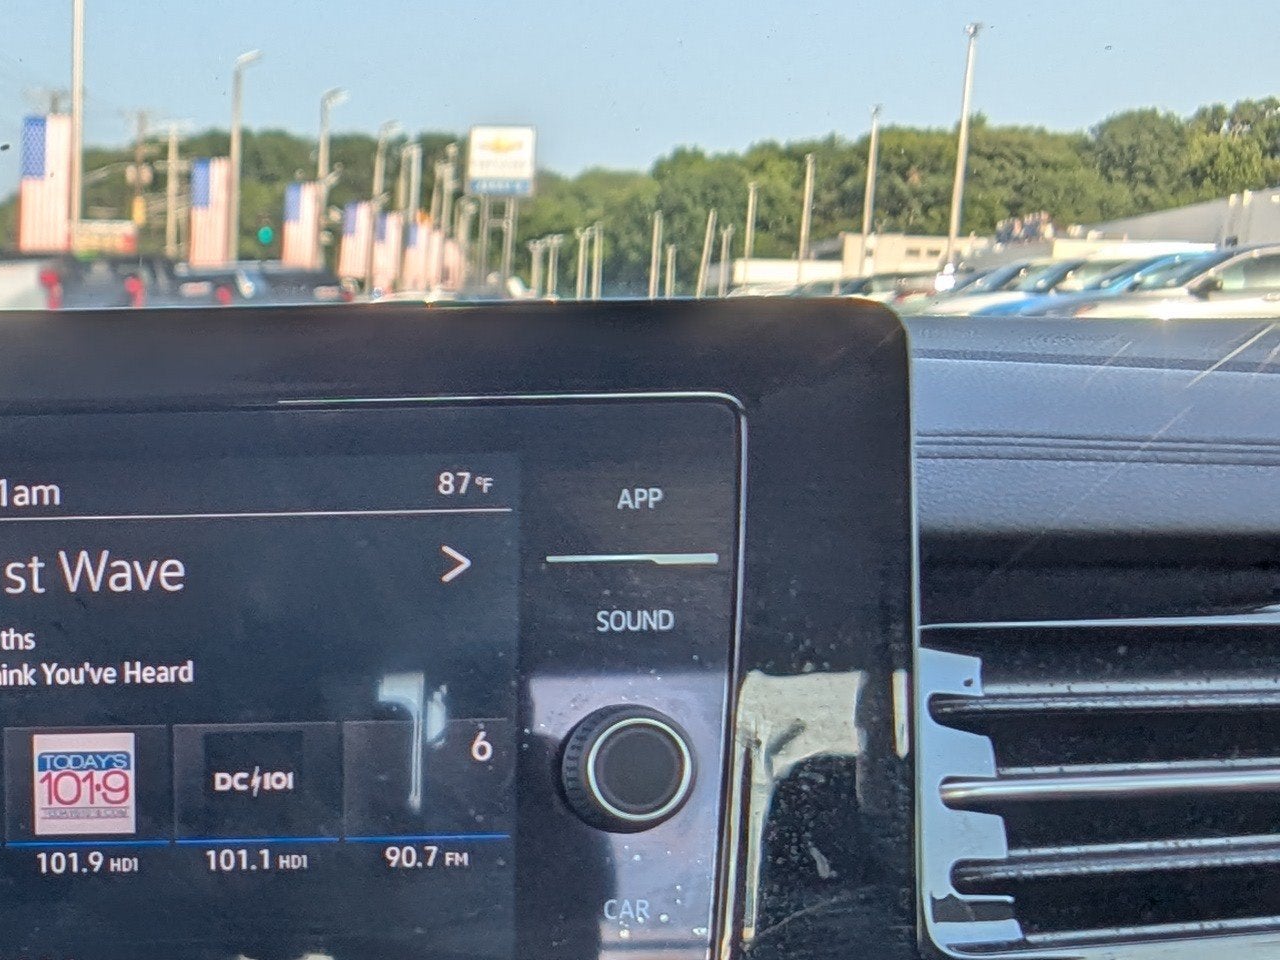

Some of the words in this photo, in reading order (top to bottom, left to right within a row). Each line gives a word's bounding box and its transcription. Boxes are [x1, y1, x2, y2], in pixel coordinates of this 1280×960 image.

[617, 487, 663, 510] APP
[58, 549, 186, 593] Wave
[596, 609, 675, 632] SOUND
[40, 661, 118, 686] You've
[124, 659, 194, 684] Heard
[471, 731, 493, 762] 6
[36, 850, 104, 874] 101.9
[206, 848, 270, 871] 101.1
[385, 845, 439, 868] 90.7
[444, 851, 469, 867] FM
[604, 898, 651, 922] CAR
